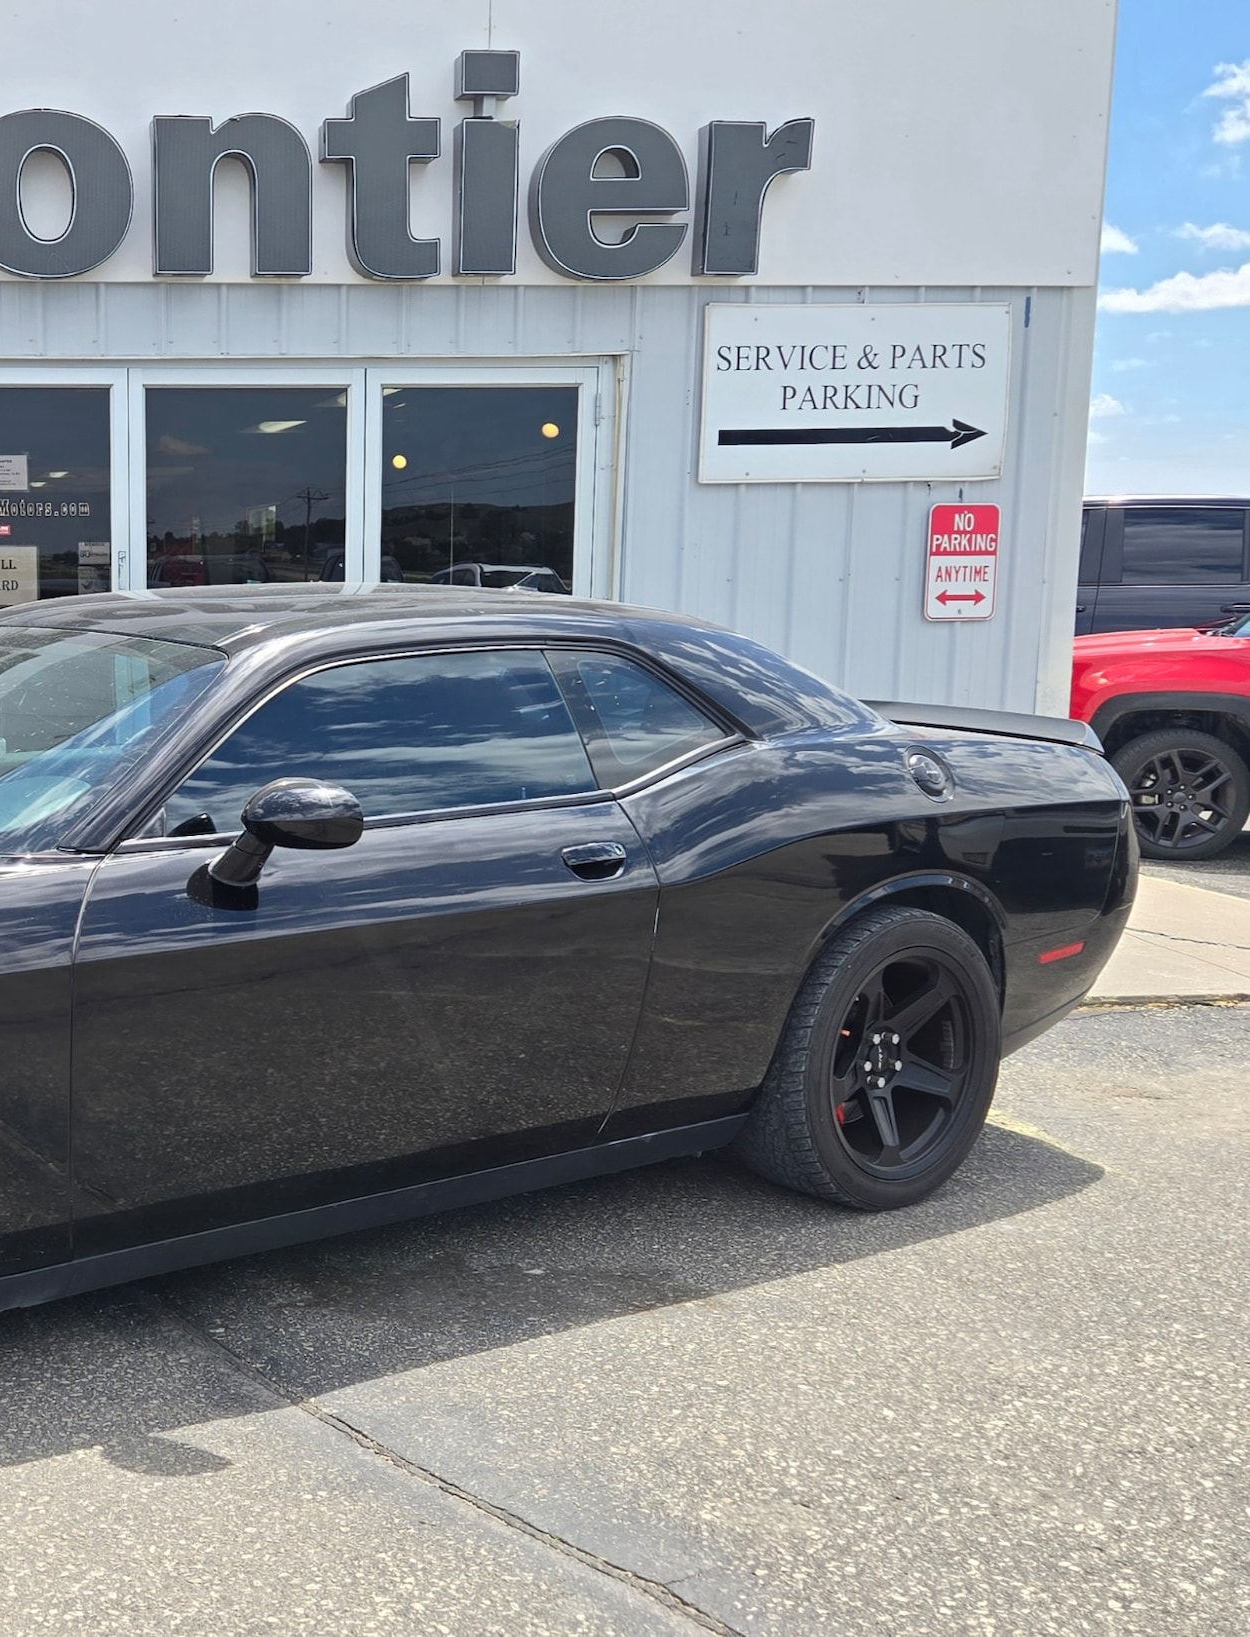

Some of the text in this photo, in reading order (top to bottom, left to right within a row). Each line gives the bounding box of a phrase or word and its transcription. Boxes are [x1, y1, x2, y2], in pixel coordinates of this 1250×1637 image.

[716, 343, 986, 371] SERVICE & PARTS
[780, 383, 920, 410] PARKING
[953, 513, 975, 531] NO
[932, 533, 997, 552] PARKING
[935, 565, 990, 582] ANYTIME
